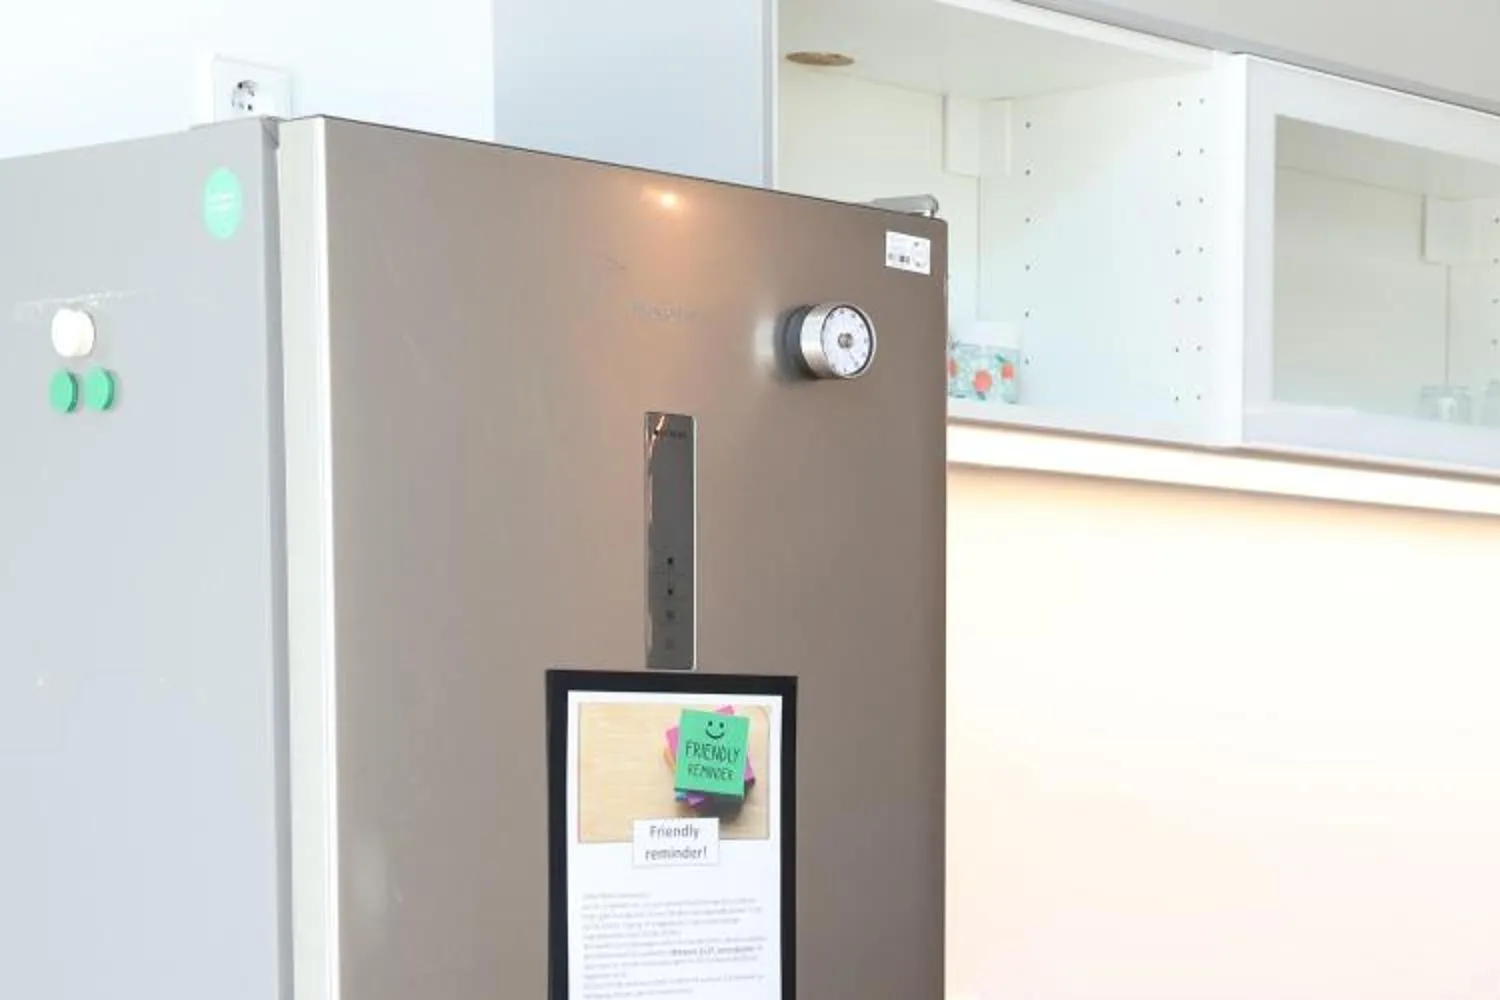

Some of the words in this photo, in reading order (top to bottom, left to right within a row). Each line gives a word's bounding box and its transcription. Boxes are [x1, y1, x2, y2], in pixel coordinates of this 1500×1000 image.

[685, 741, 741, 764] FRIENDLY
[687, 763, 735, 781] REMINDER
[649, 824, 700, 840] Friendly
[645, 846, 707, 861] reminder!
